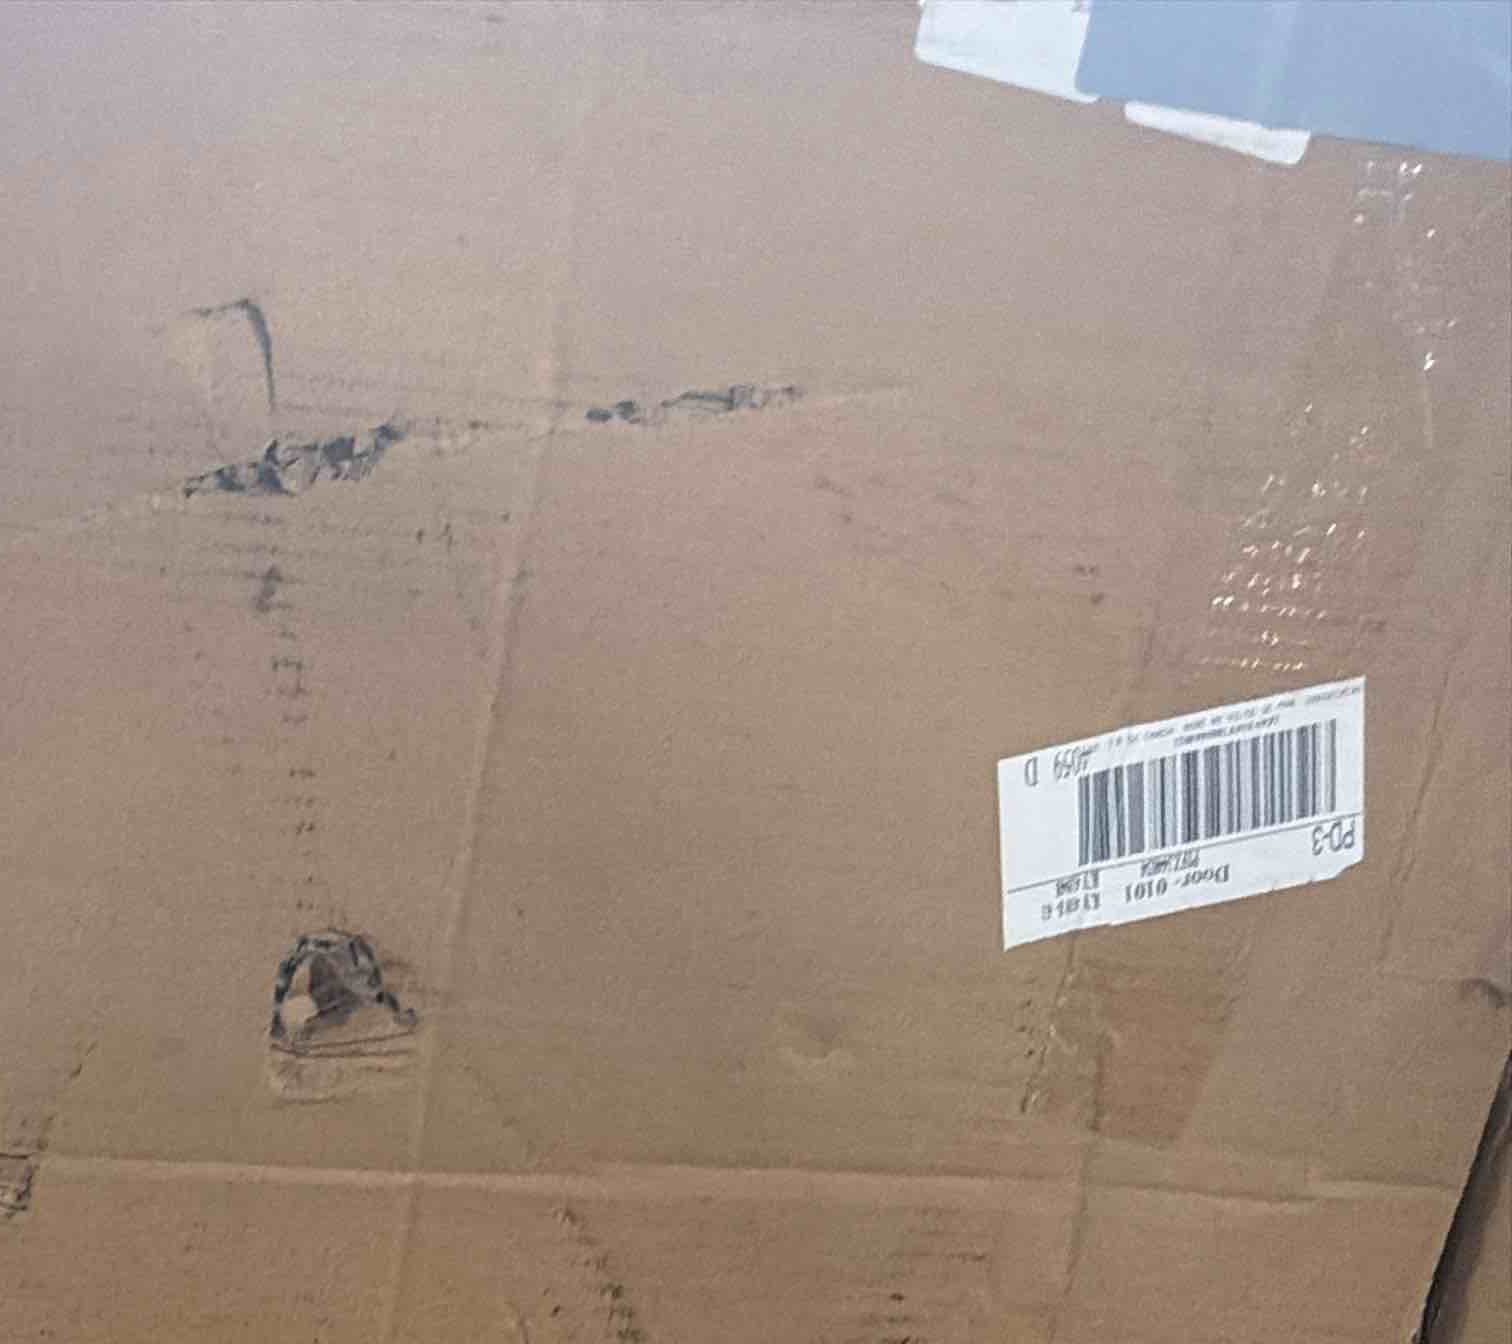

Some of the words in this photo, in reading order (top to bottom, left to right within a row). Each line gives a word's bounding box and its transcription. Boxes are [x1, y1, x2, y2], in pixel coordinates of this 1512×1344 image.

[1024, 757, 1039, 787] D
[1311, 824, 1357, 857] PD-3
[1124, 878, 1169, 904] 0101
